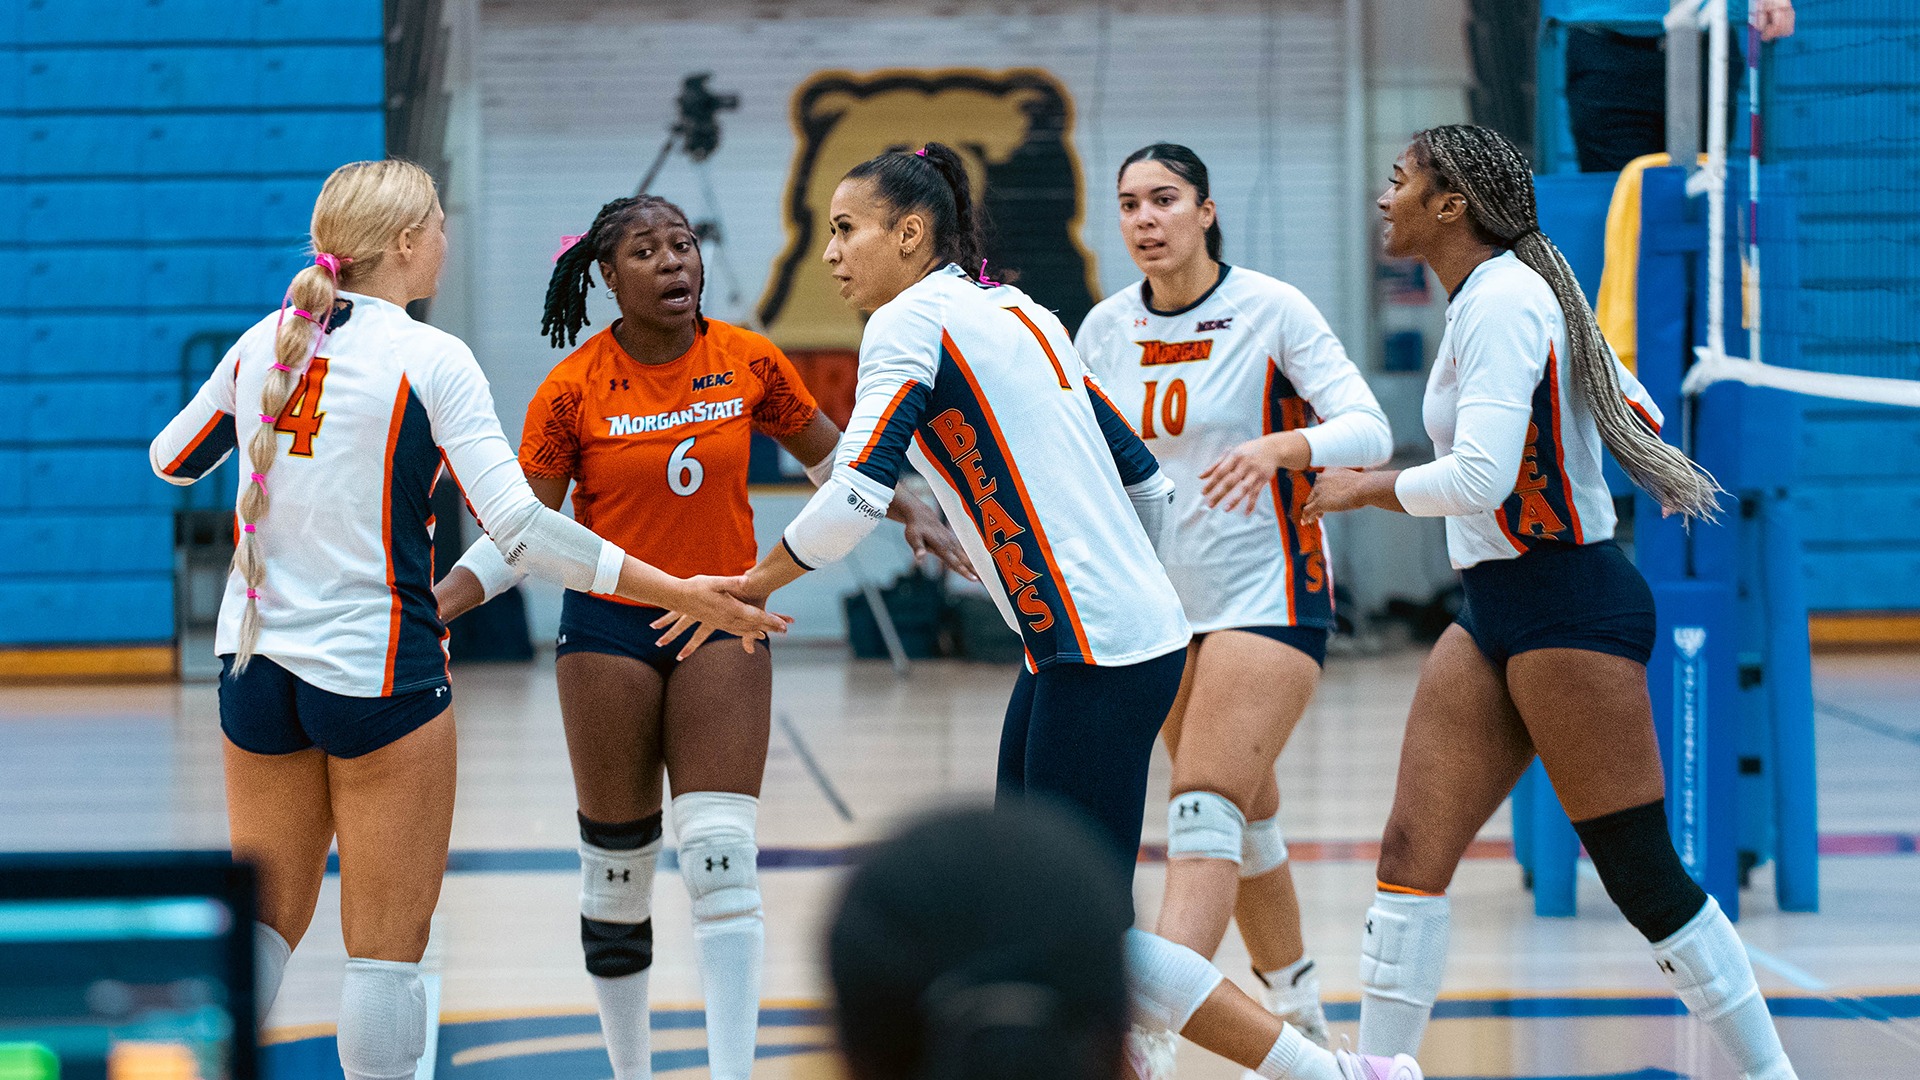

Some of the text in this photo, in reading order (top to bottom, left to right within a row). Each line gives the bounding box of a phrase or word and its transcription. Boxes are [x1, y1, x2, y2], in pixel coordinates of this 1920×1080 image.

[691, 371, 734, 392] MEAC
[1001, 305, 1073, 391] 1
[273, 356, 330, 459] 4
[1141, 378, 1188, 440] 10
[667, 436, 704, 497] 6
[928, 408, 1055, 633] BEARS
